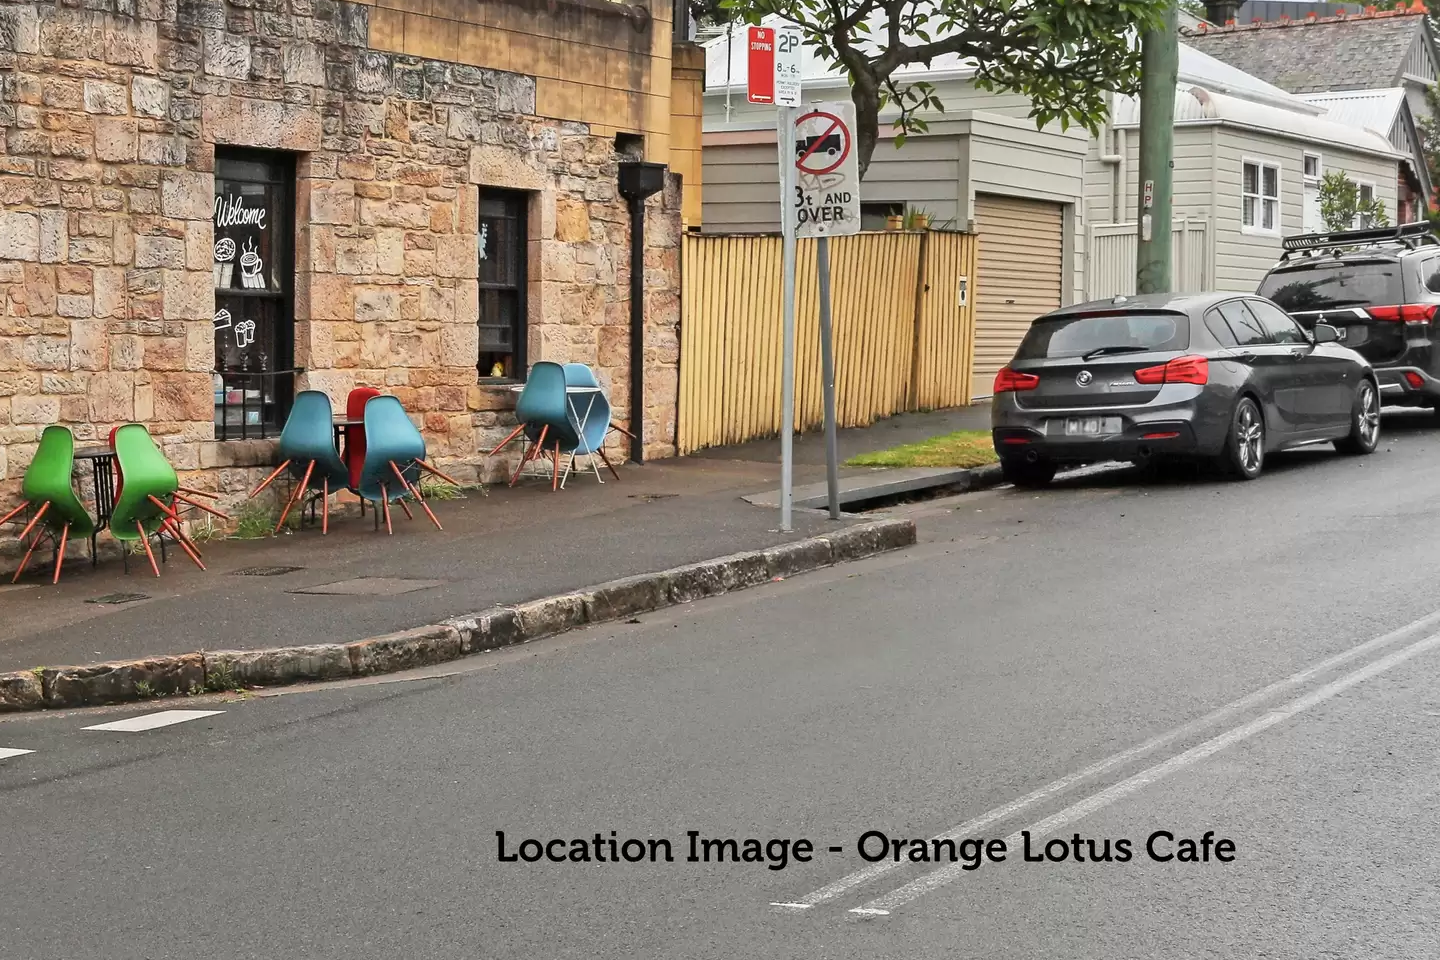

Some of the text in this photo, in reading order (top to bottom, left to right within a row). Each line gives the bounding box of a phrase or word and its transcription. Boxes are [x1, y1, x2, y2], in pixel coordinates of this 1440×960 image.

[757, 30, 766, 39] NO
[778, 34, 799, 53] 2P
[794, 185, 852, 208] 3t AND
[215, 193, 267, 229] Welcome
[797, 205, 845, 223] OVER
